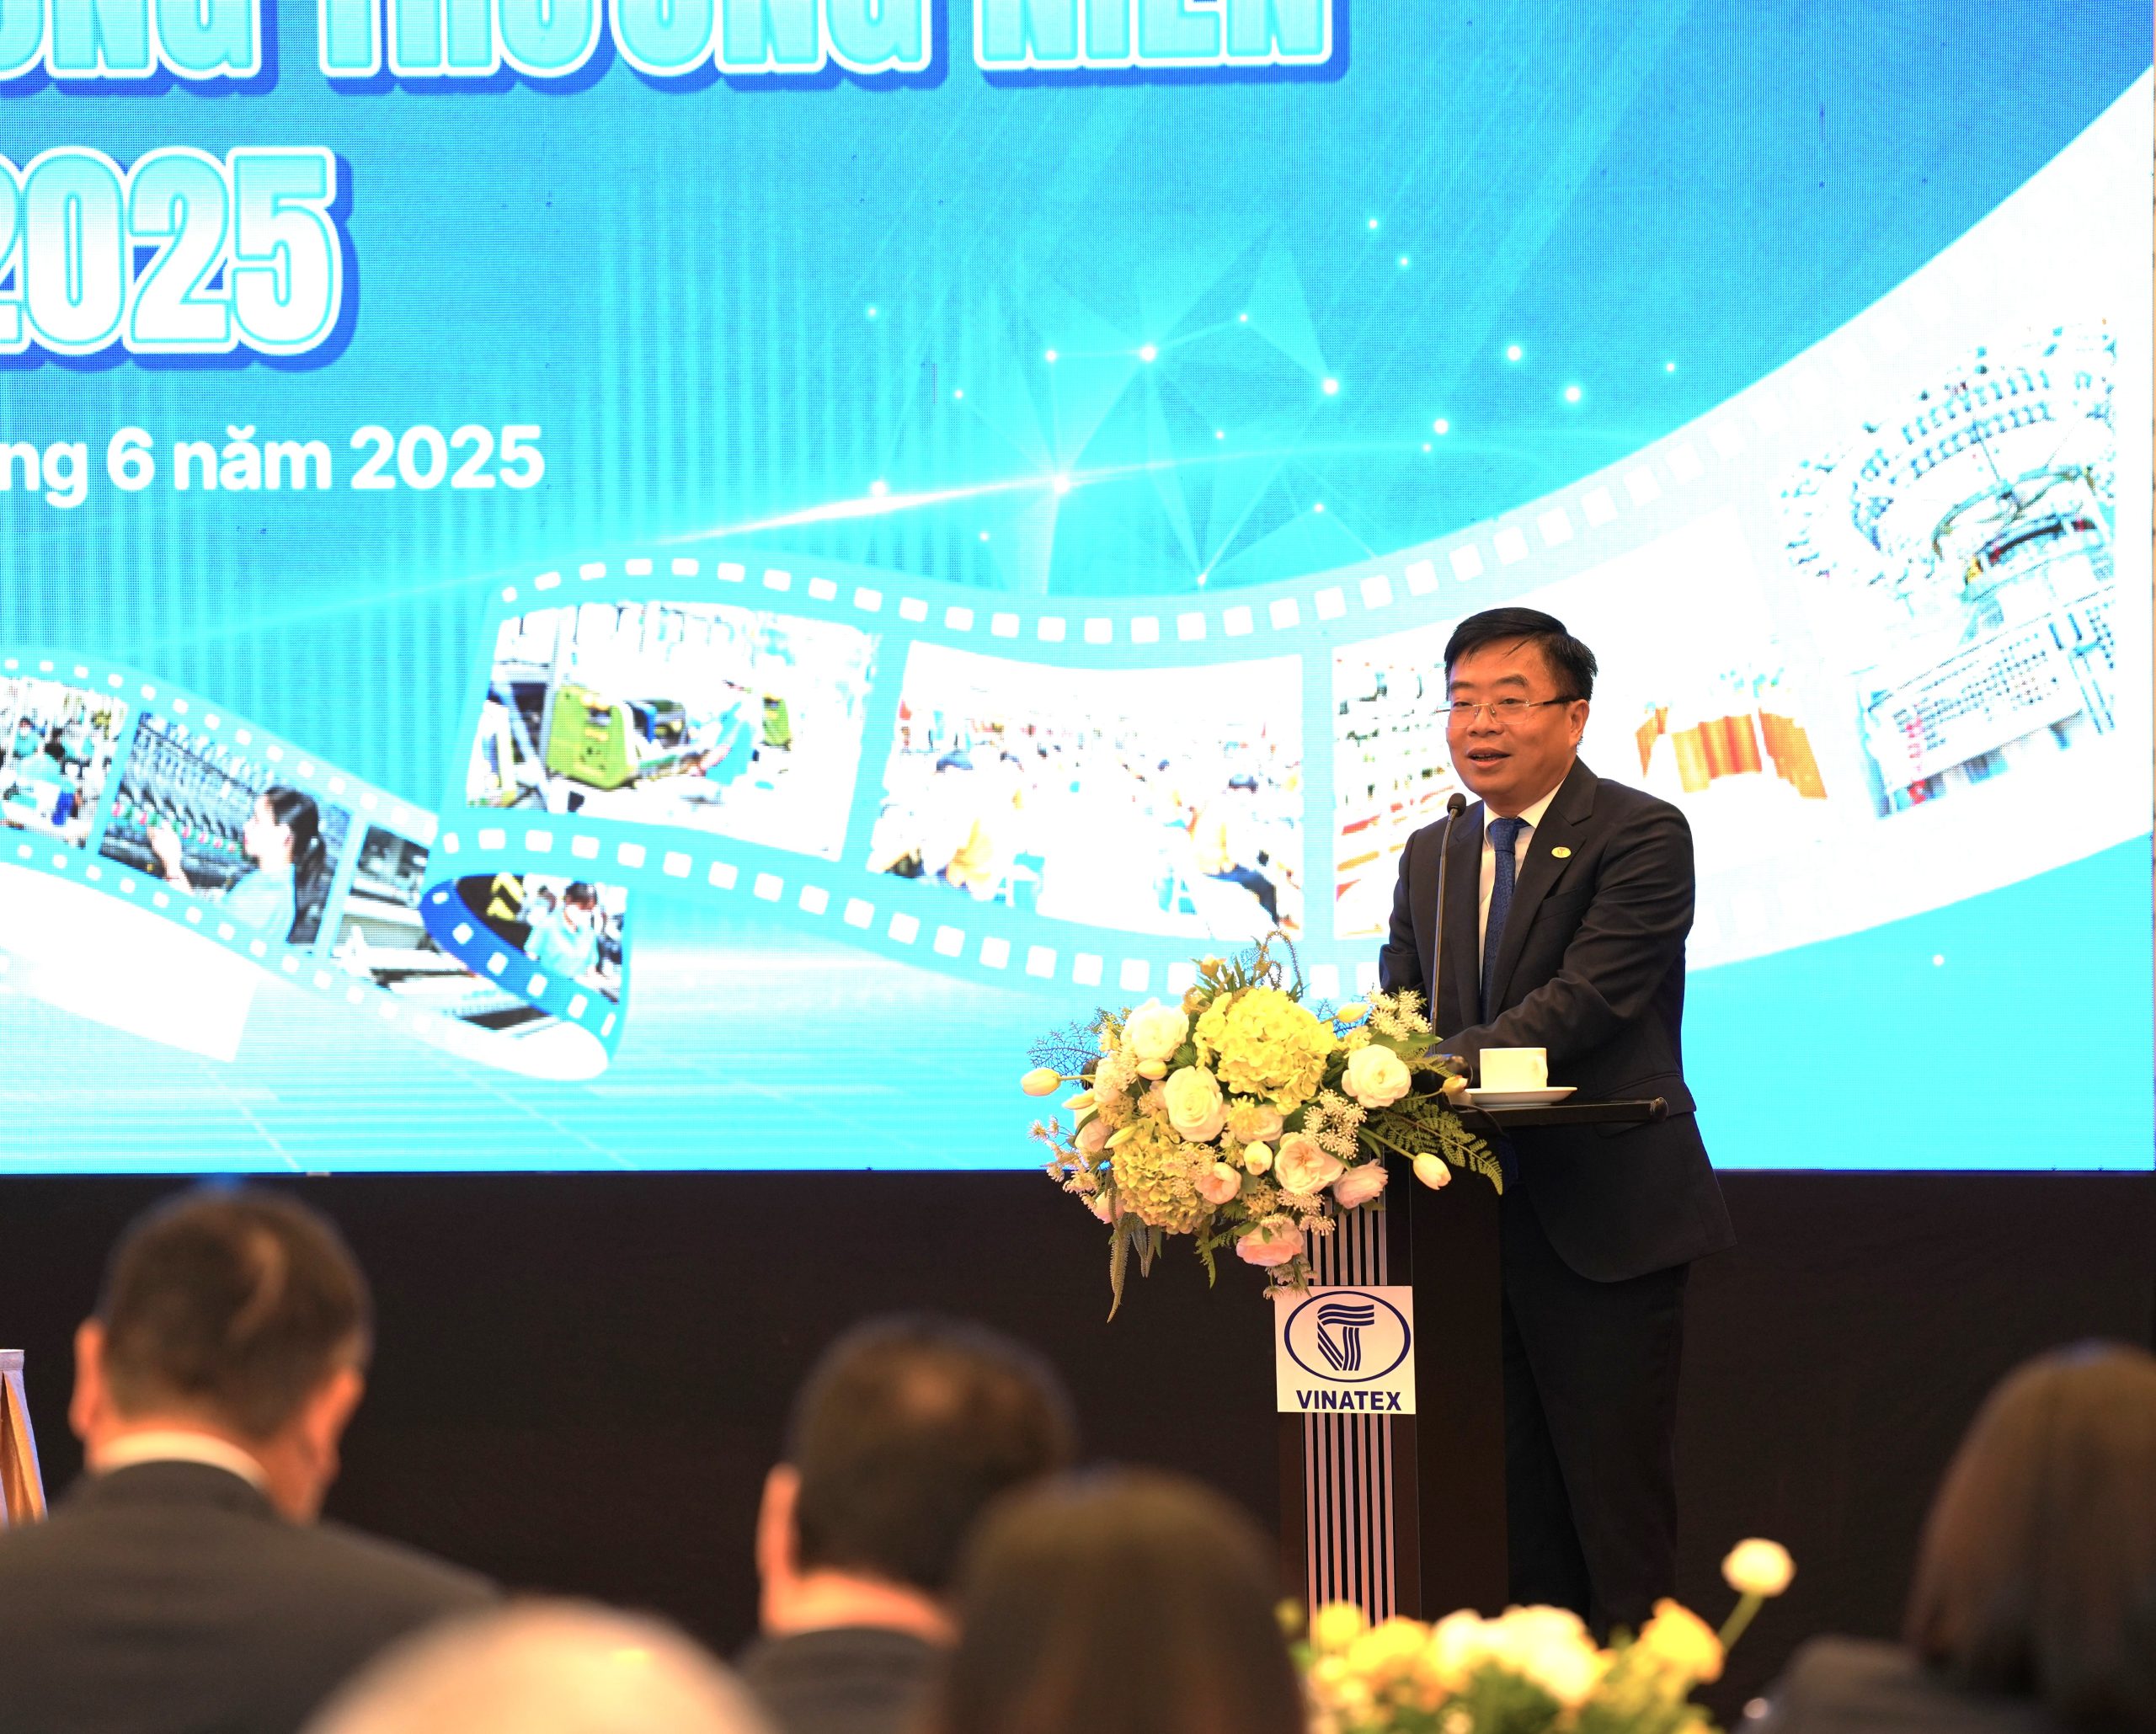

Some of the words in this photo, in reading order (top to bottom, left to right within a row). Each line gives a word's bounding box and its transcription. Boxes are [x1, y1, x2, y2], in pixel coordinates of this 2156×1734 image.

[0, 146, 343, 355] 025
[107, 427, 155, 491] 6
[173, 425, 332, 490] năm
[350, 425, 545, 490] 2025
[1296, 1390, 1401, 1411] VINATEX
